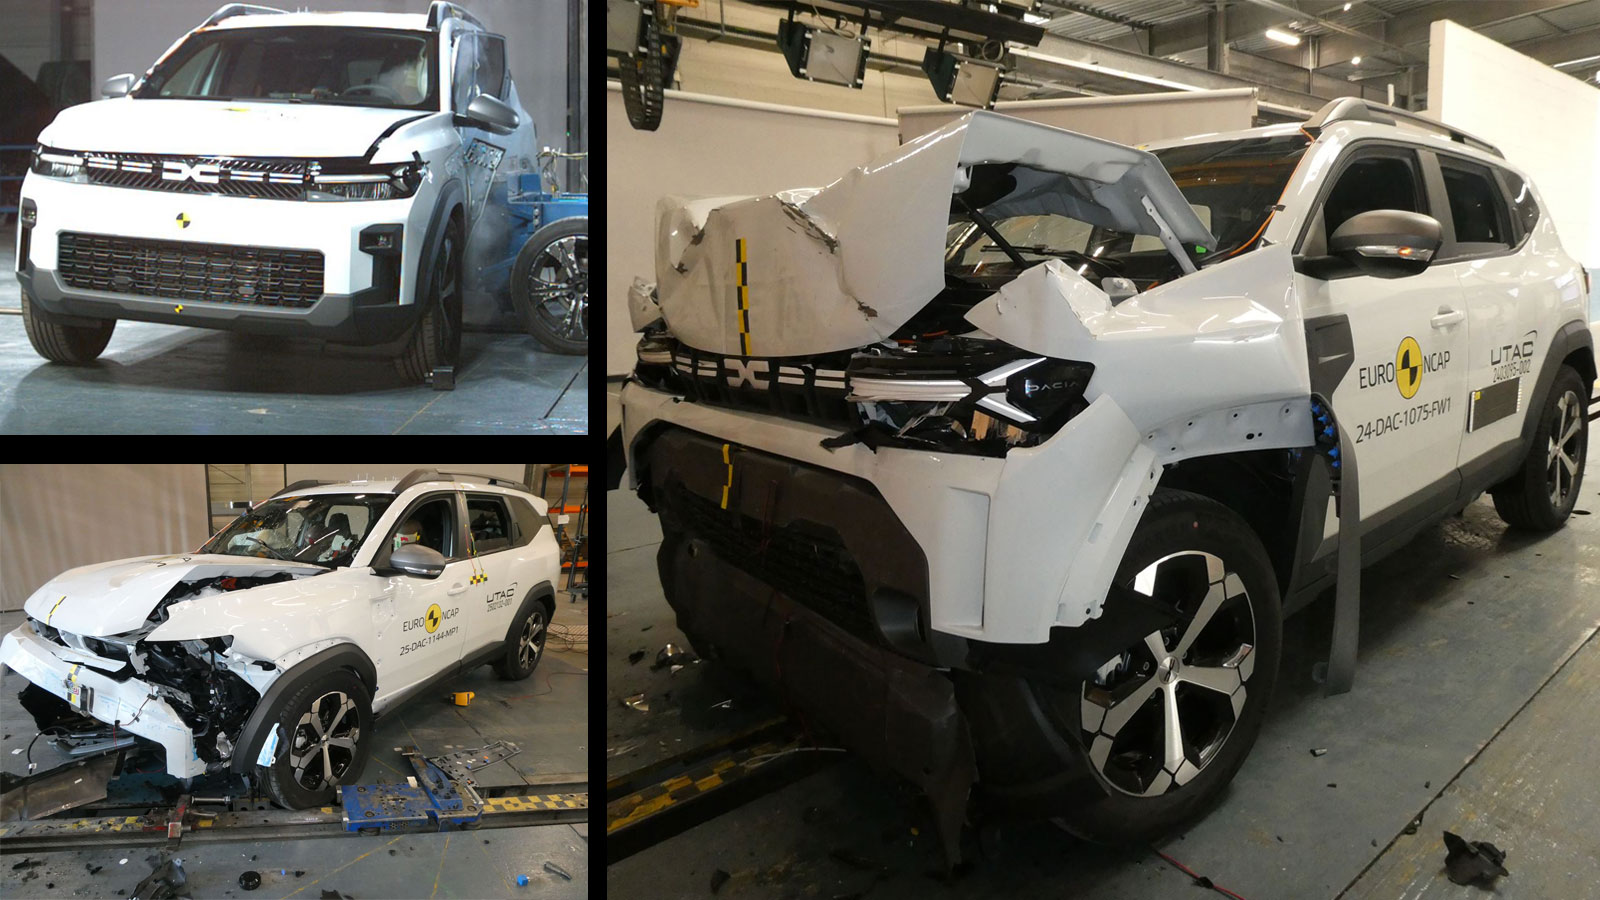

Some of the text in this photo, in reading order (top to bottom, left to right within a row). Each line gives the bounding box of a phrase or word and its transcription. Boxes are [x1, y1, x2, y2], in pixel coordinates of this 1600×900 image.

[1490, 340, 1534, 366] UTAC
[1359, 350, 1451, 389] EURO NCAP
[1025, 381, 1080, 392] DACIA
[1355, 396, 1451, 444] 24-DAC-1075-FW1
[486, 588, 515, 603] UTAC
[402, 608, 459, 632] EURO NCAP
[400, 626, 459, 656] 25-DAC-1144-MP1
